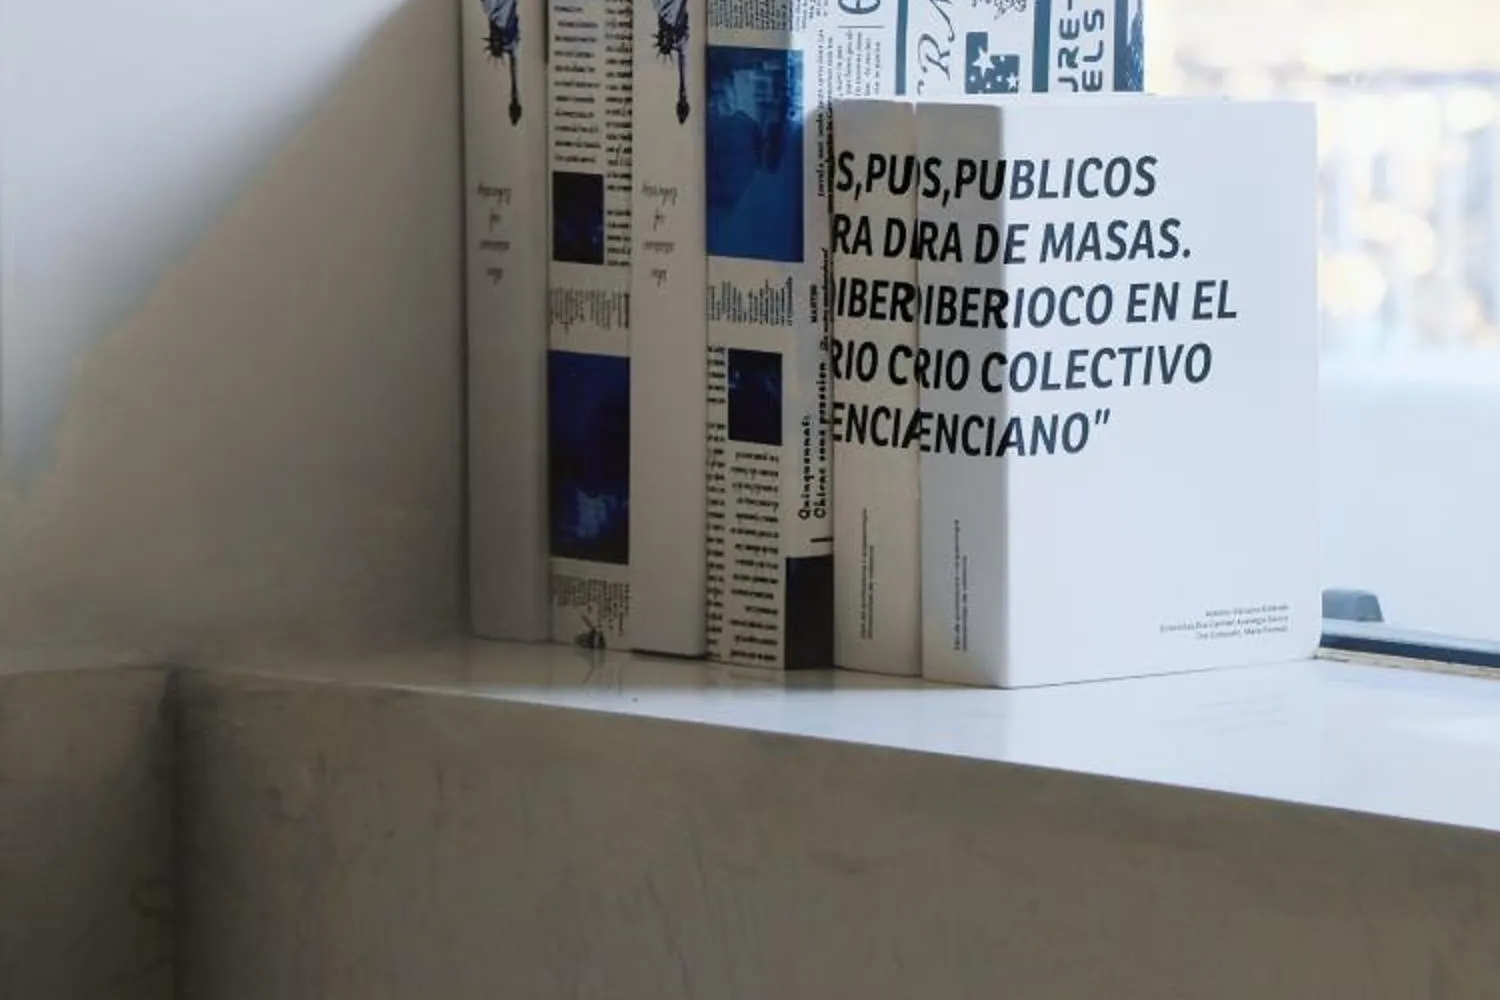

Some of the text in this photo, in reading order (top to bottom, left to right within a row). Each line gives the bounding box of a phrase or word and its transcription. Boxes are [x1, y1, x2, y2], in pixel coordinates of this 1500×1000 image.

[1082, 8, 1105, 93] ELS
[917, 155, 1158, 208] S,PUBLICOS
[974, 223, 1029, 265] DE
[1039, 217, 1191, 263] MASAS.
[833, 276, 916, 323] IBER
[918, 279, 1237, 329] IBERIOCO EN EL
[981, 342, 1212, 393] COLECTIVO
